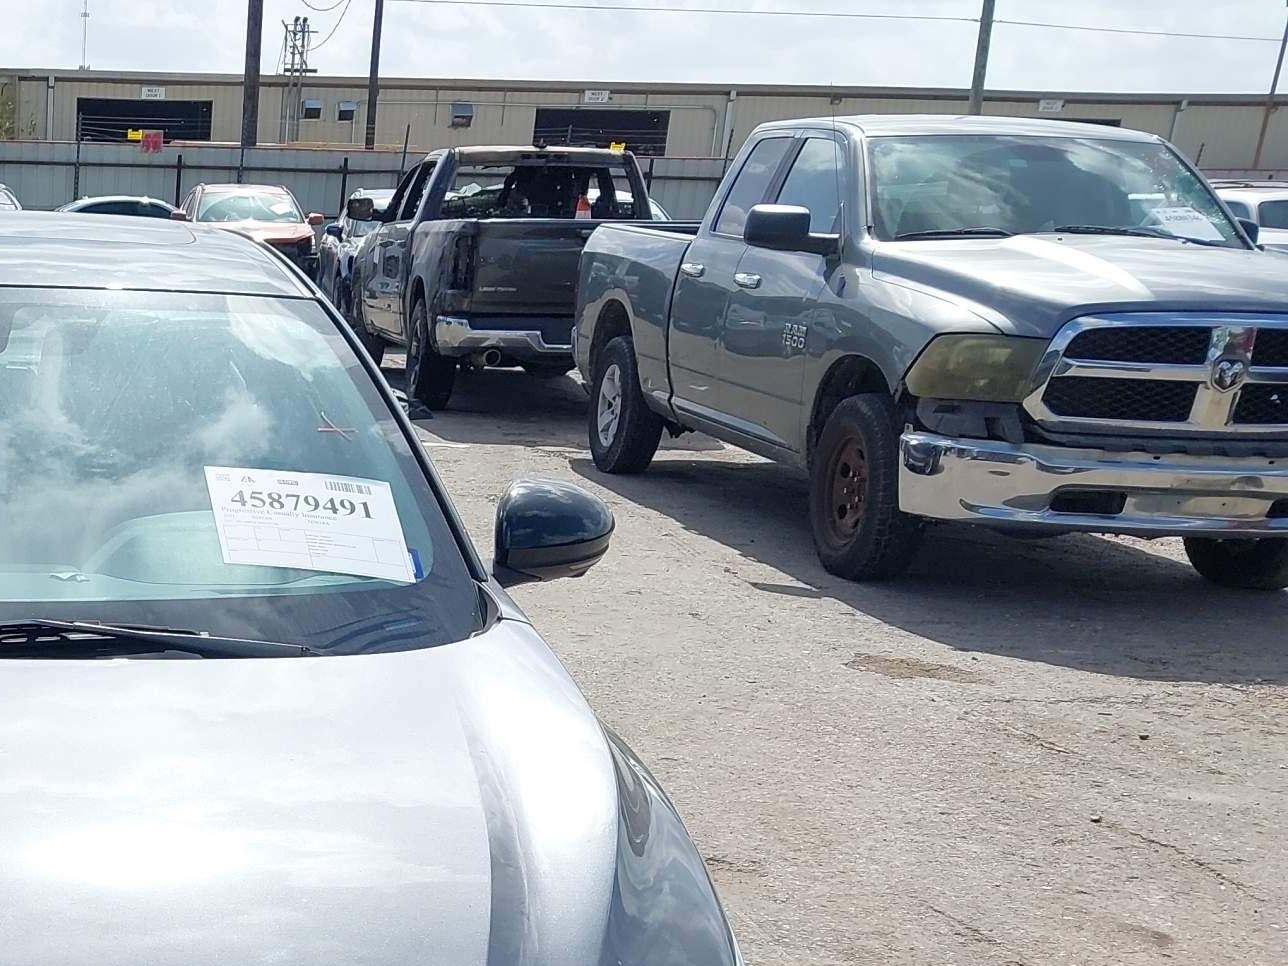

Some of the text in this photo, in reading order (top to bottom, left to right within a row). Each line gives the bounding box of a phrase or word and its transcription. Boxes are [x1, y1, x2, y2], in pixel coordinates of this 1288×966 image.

[784, 322, 807, 337] RAM
[782, 334, 805, 349] 1500
[231, 489, 376, 520] 45879491
